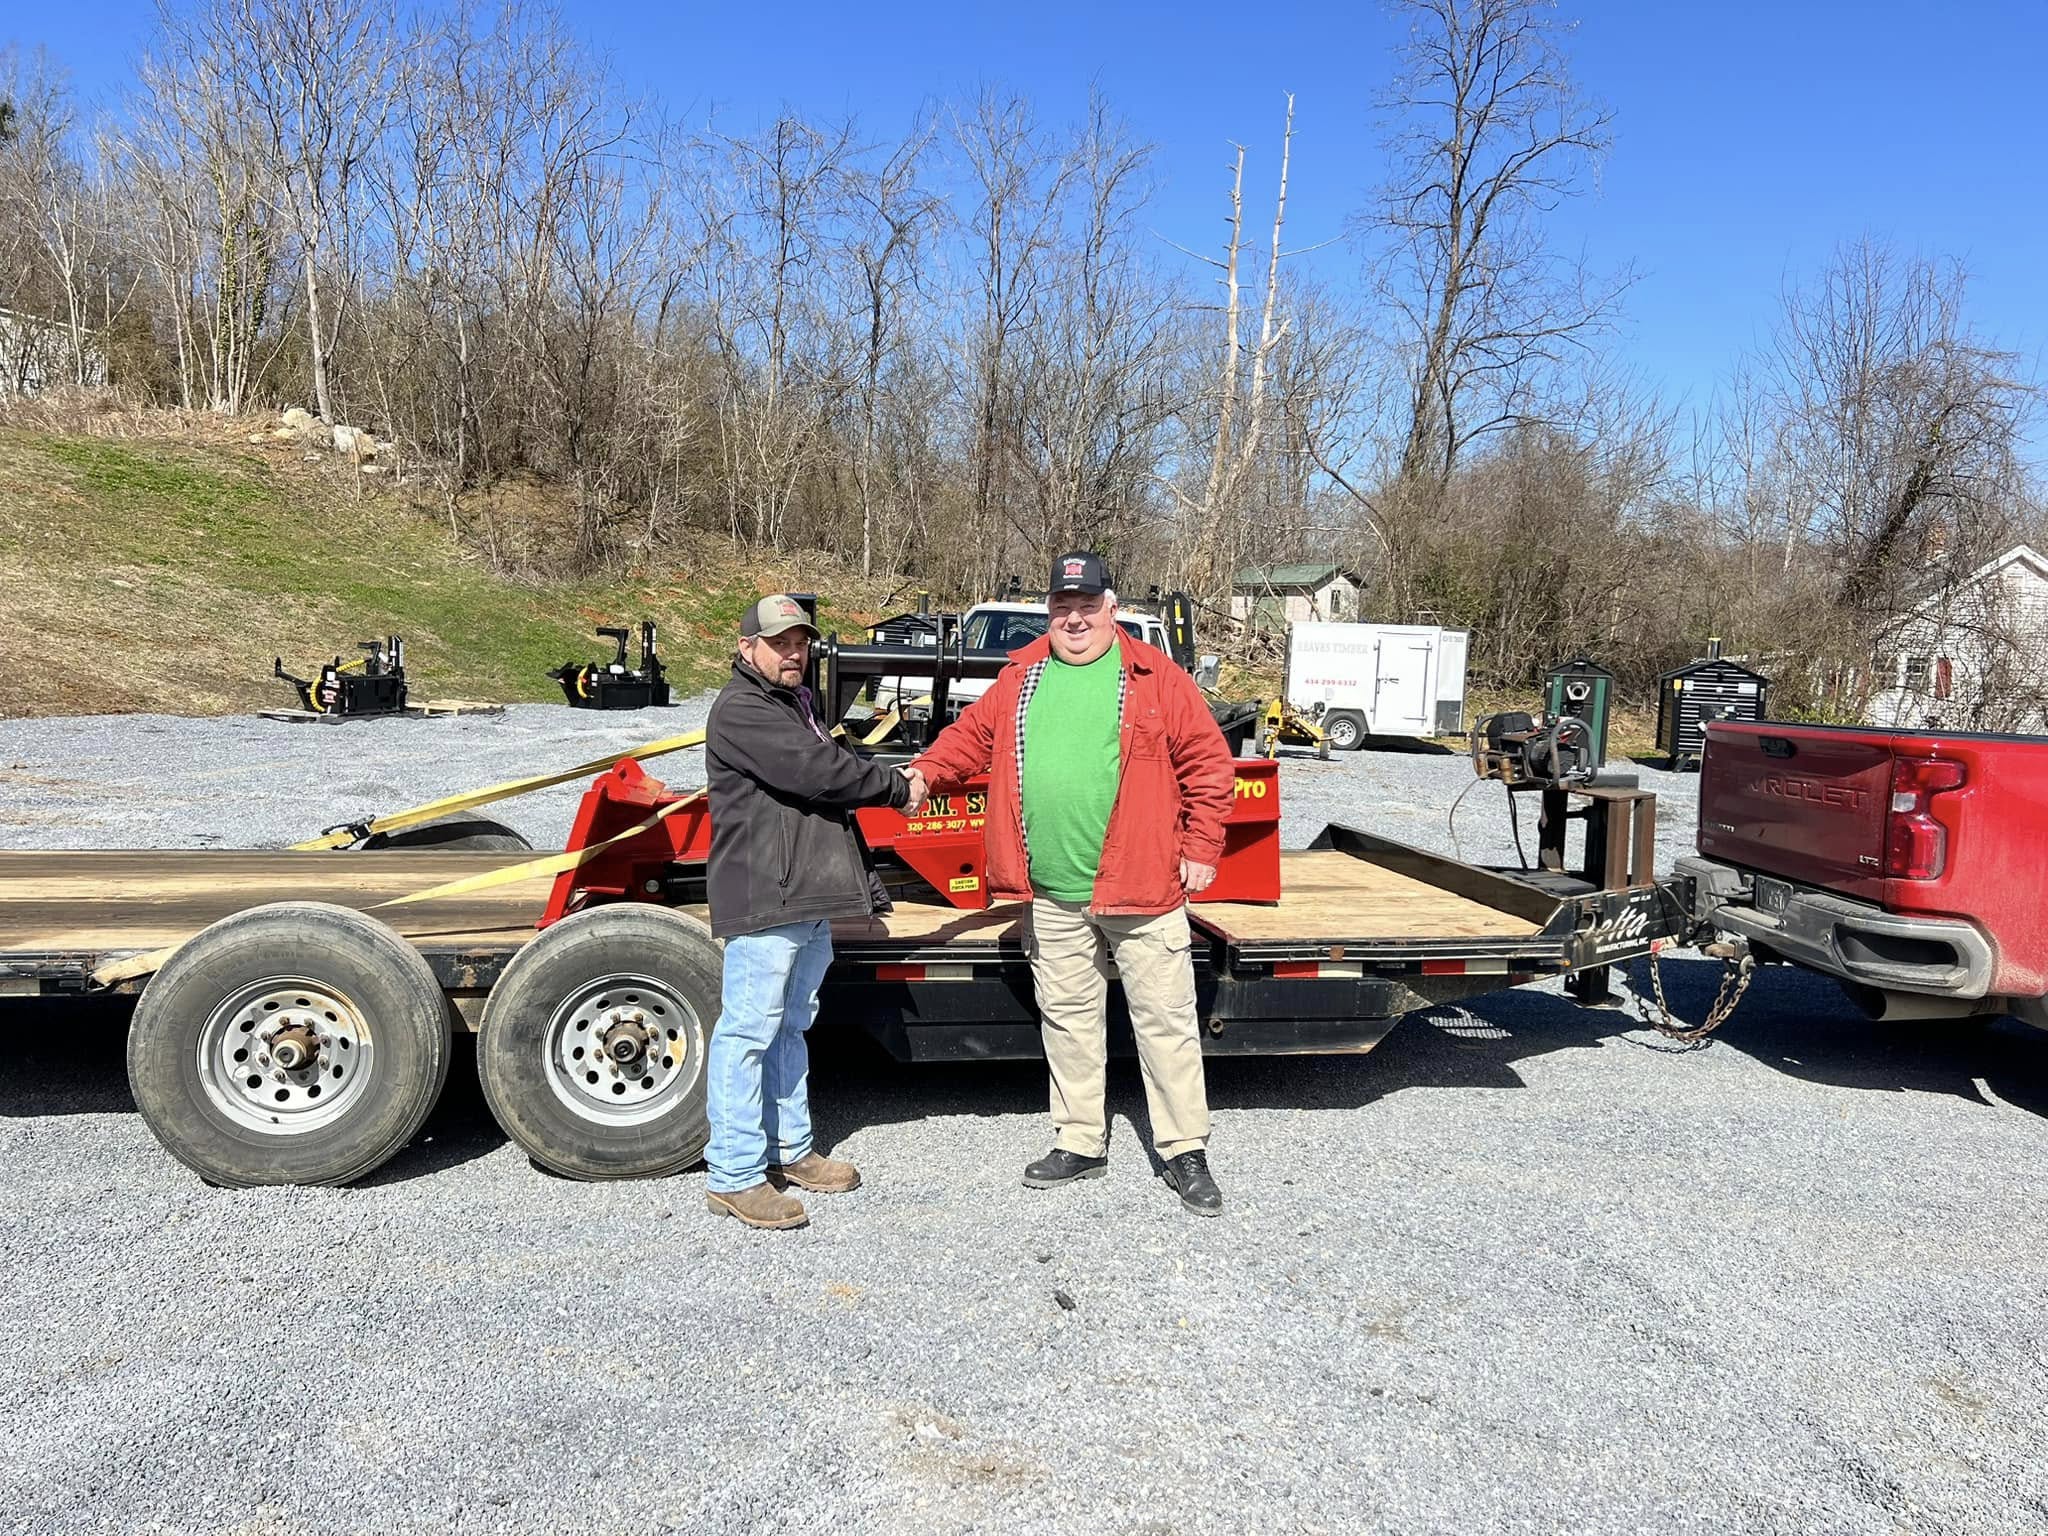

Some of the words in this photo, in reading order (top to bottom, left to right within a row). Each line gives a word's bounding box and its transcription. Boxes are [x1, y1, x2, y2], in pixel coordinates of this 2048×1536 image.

[1234, 777, 1266, 799] Pro
[909, 793, 957, 818] .M.
[907, 820, 966, 832] 320-286-3077
[1859, 855, 1879, 866] LTZ
